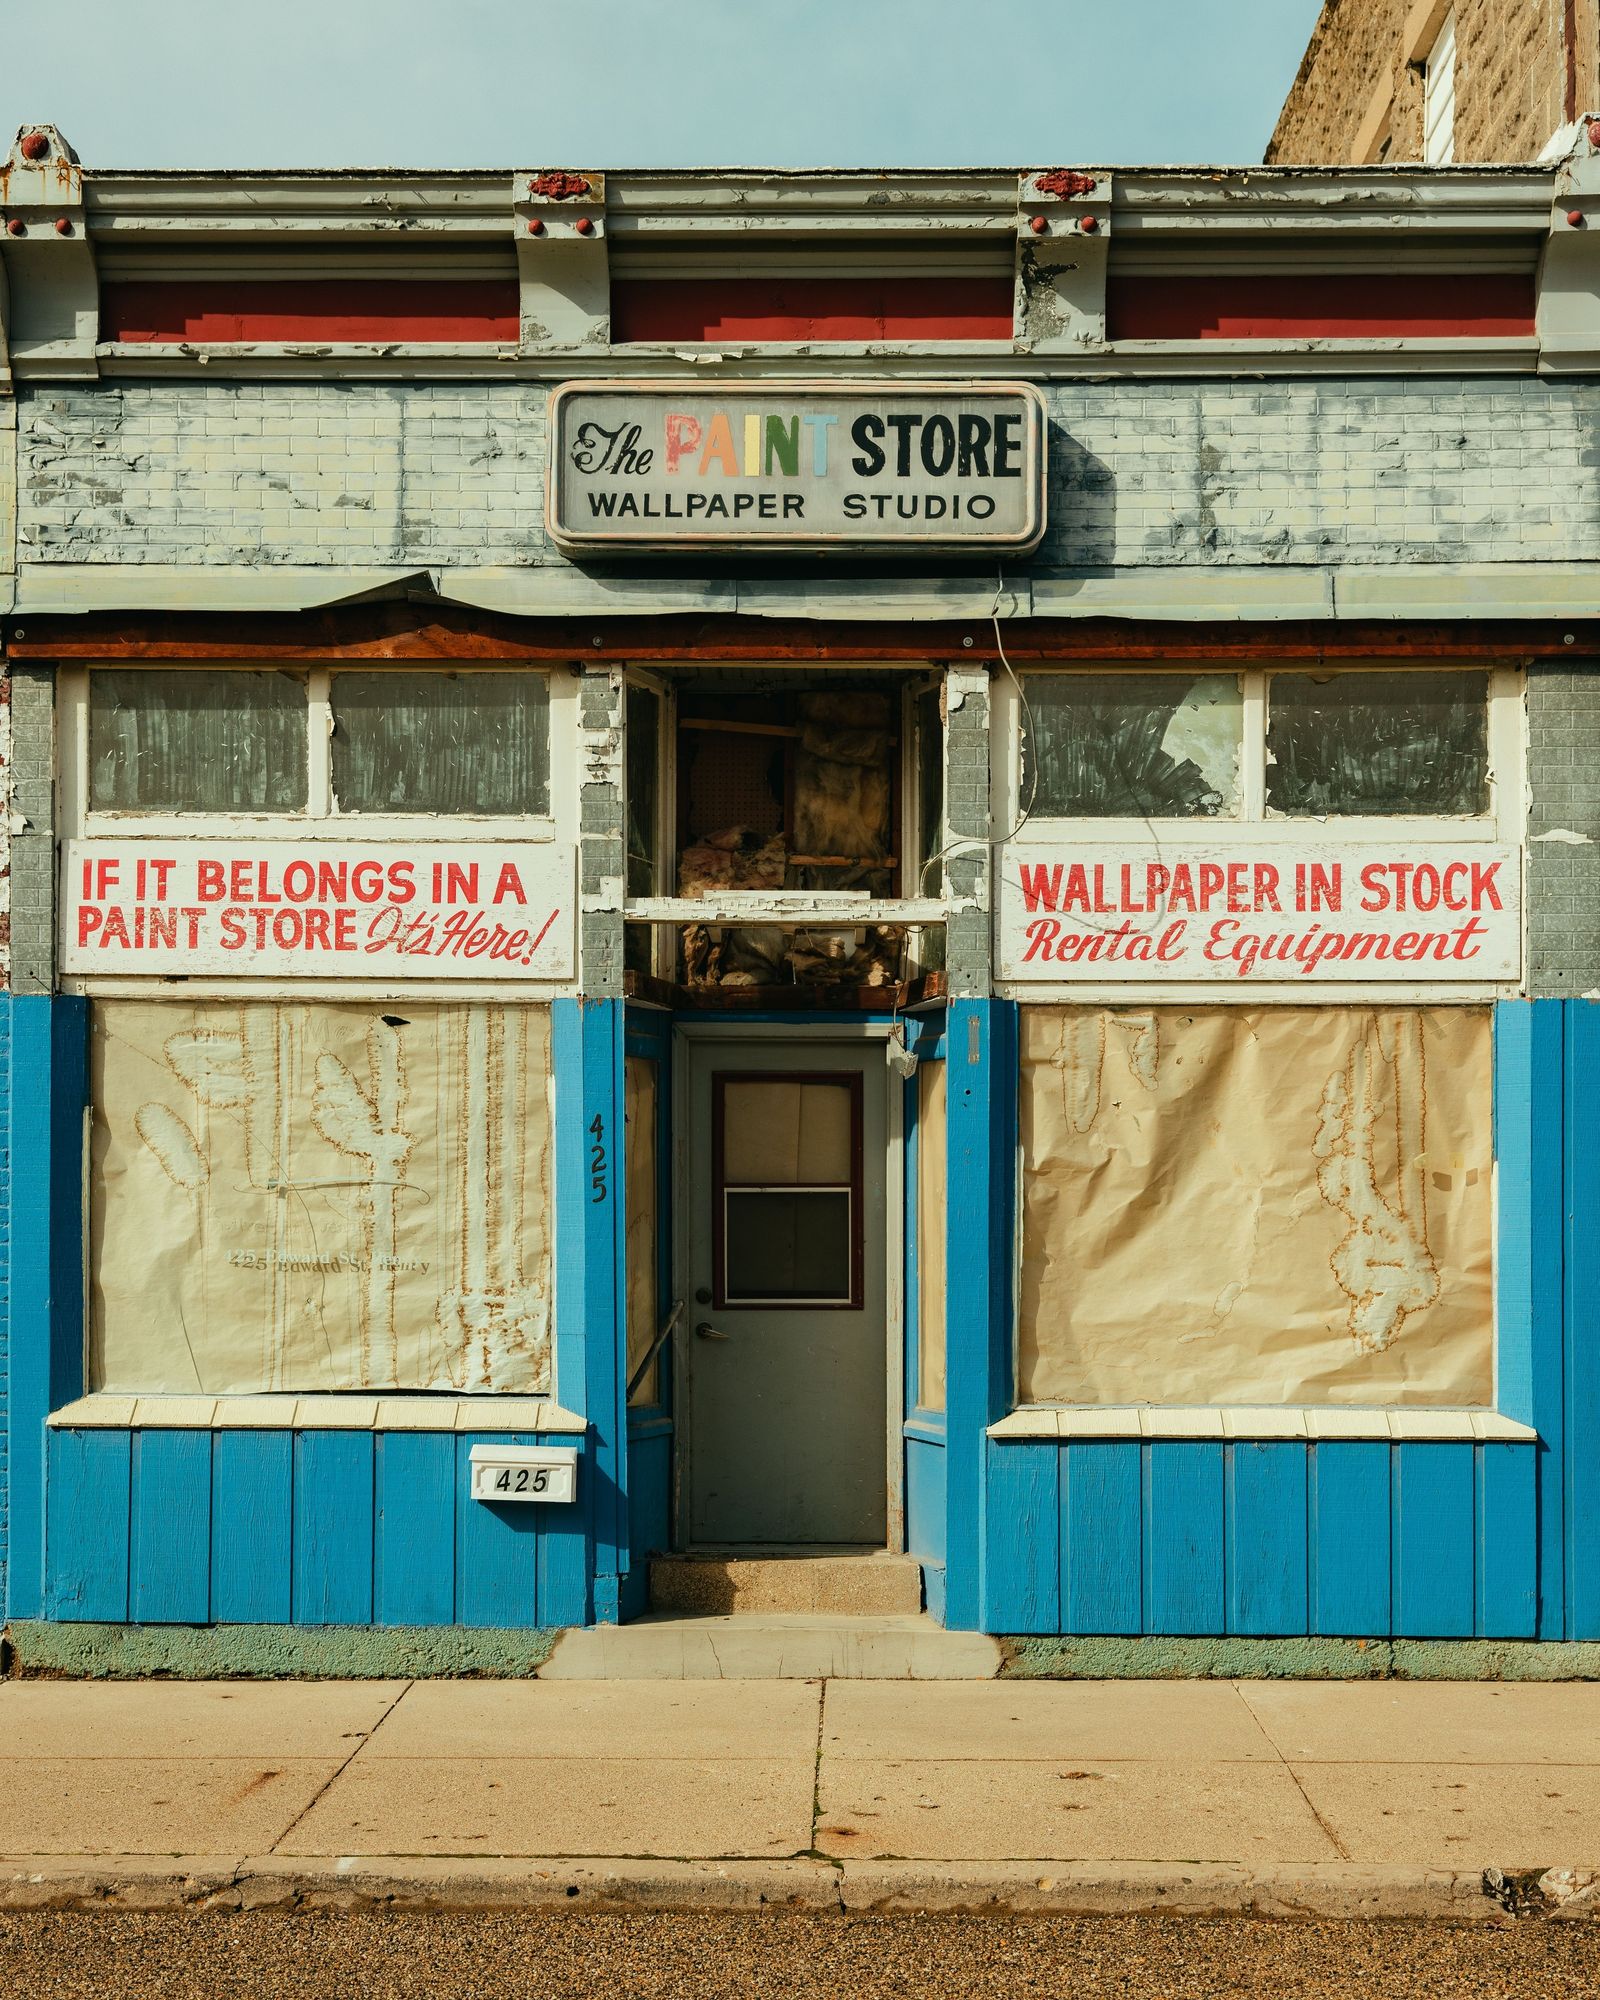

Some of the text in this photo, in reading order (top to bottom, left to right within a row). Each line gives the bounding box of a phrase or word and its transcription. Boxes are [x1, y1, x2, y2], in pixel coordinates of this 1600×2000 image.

[570, 413, 1022, 478] The PAINT STORE
[587, 492, 996, 520] WALLPAPER STUDIO
[82, 858, 528, 905] IF IT BELONGS IN A
[1018, 861, 1504, 914] WALLPAPER IN STOCK
[77, 905, 560, 966] PAINT STORE It's Here!
[1020, 916, 1490, 977] Rental Equipment
[588, 1112, 607, 1204] 425
[225, 1249, 267, 1271] 425
[268, 1249, 342, 1273] Edward
[496, 1469, 548, 1493] 425
